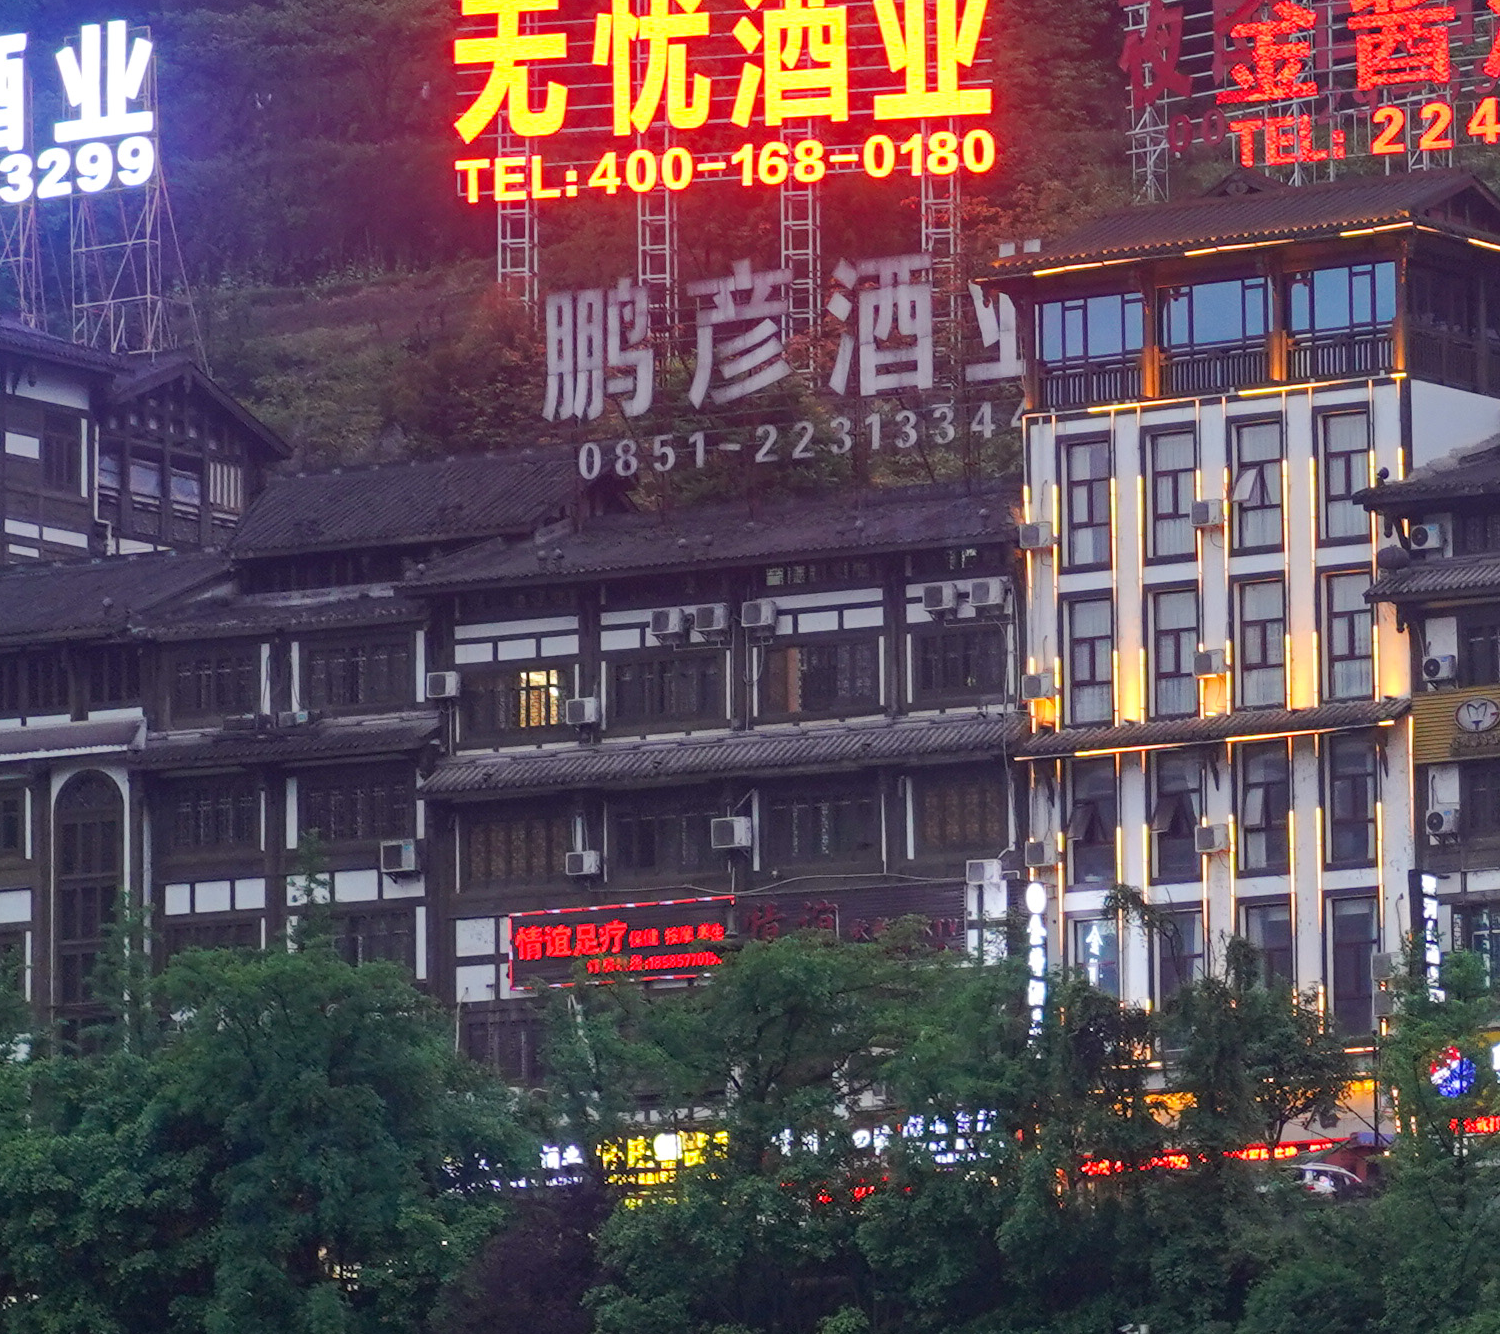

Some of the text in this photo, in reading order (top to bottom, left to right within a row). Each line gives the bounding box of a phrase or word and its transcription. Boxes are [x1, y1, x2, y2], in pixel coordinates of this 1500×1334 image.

[1229, 113, 1346, 168] TEL:
[514, 917, 629, 961] 情谊足疗
